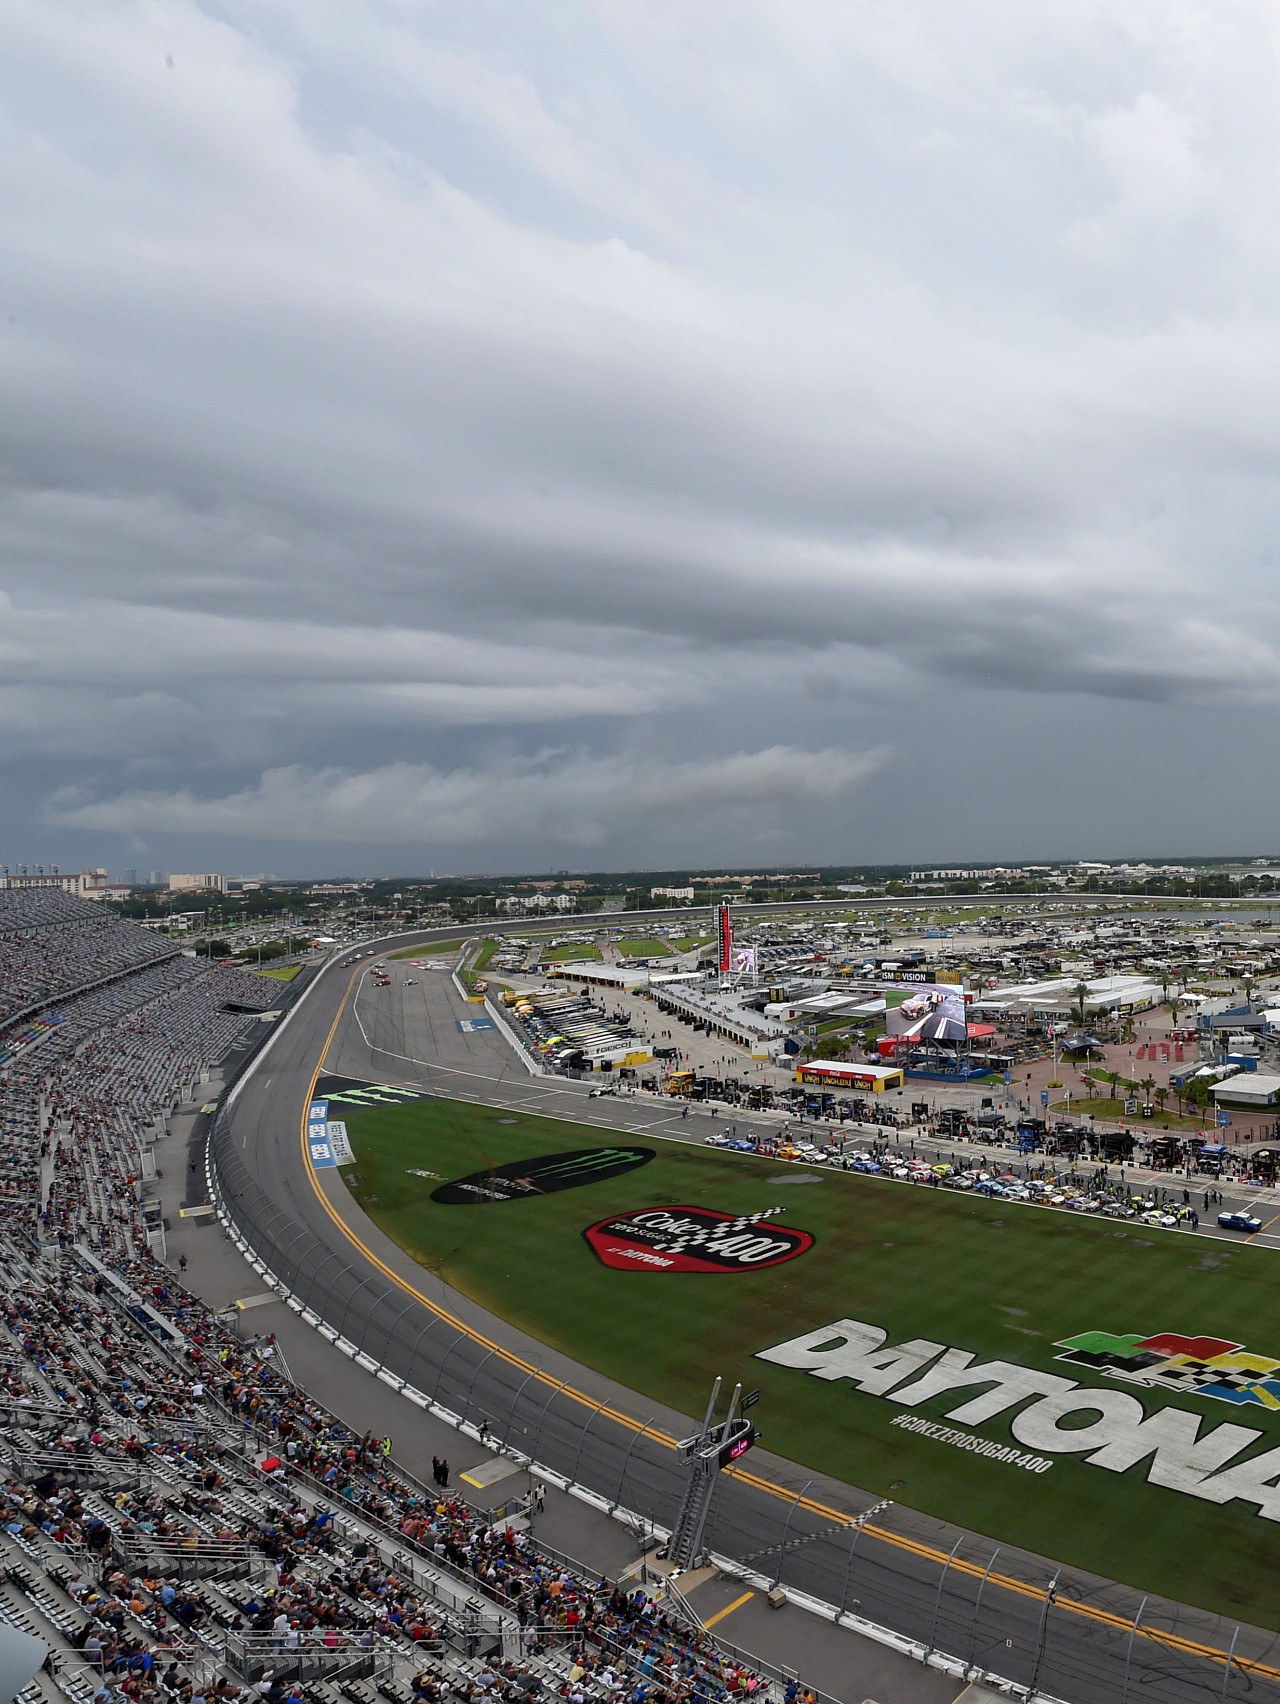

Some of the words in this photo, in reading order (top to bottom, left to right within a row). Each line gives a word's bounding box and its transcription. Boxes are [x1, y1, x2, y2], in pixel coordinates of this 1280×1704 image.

[902, 973, 926, 982] VISION
[600, 1042, 628, 1053] GEICO
[804, 1073, 819, 1083] UNOH
[854, 1080, 870, 1089] UNOH
[608, 1223, 638, 1232] zero
[634, 1229, 671, 1241] SUGAR
[632, 1212, 702, 1234] Coke
[705, 1233, 792, 1262] 400
[618, 1249, 675, 1267] DAYTONA
[889, 1414, 1054, 1474] #COKEZEROSUGAR400
